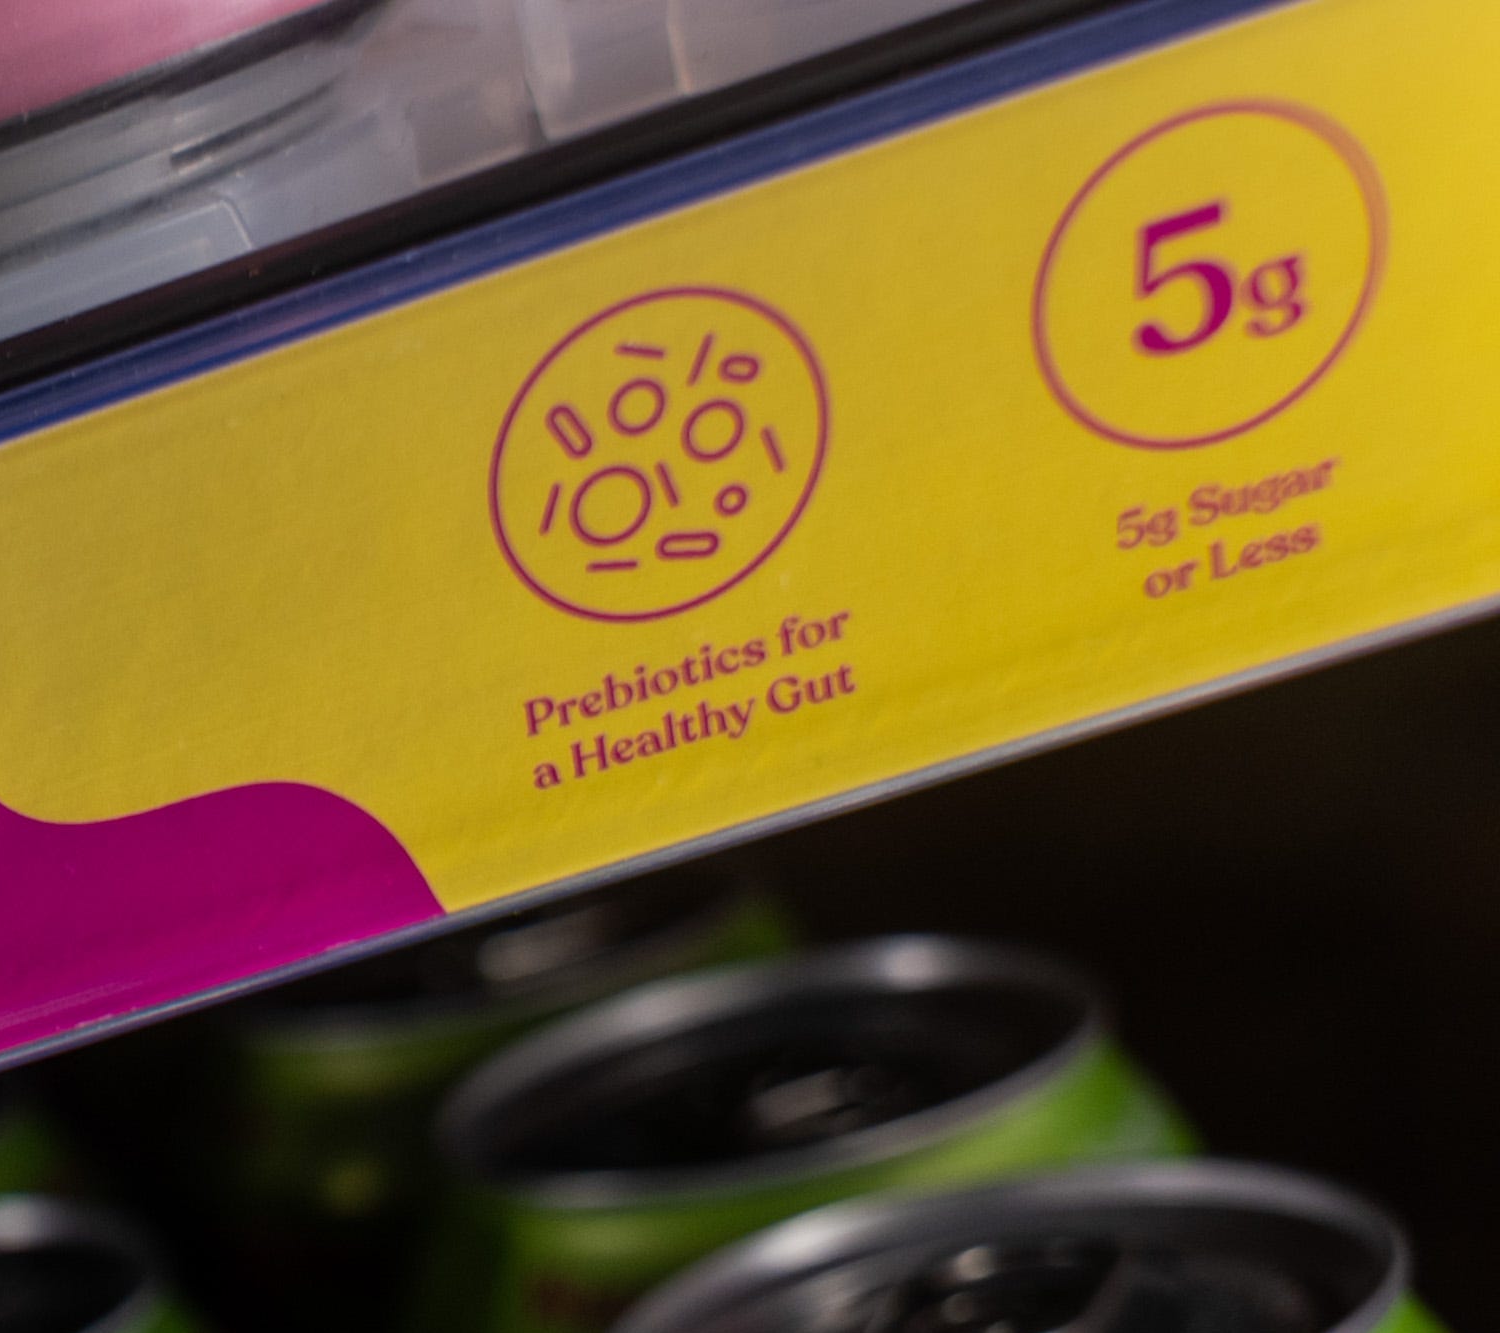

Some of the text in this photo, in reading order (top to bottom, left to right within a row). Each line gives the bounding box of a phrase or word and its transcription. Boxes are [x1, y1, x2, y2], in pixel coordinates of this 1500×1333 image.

[1130, 194, 1312, 361] 5g
[1113, 453, 1342, 556] 5g Sugar
[1140, 519, 1325, 603] or Less
[519, 604, 854, 740] Prebiotics for
[530, 659, 860, 793] a Healthy Gut
